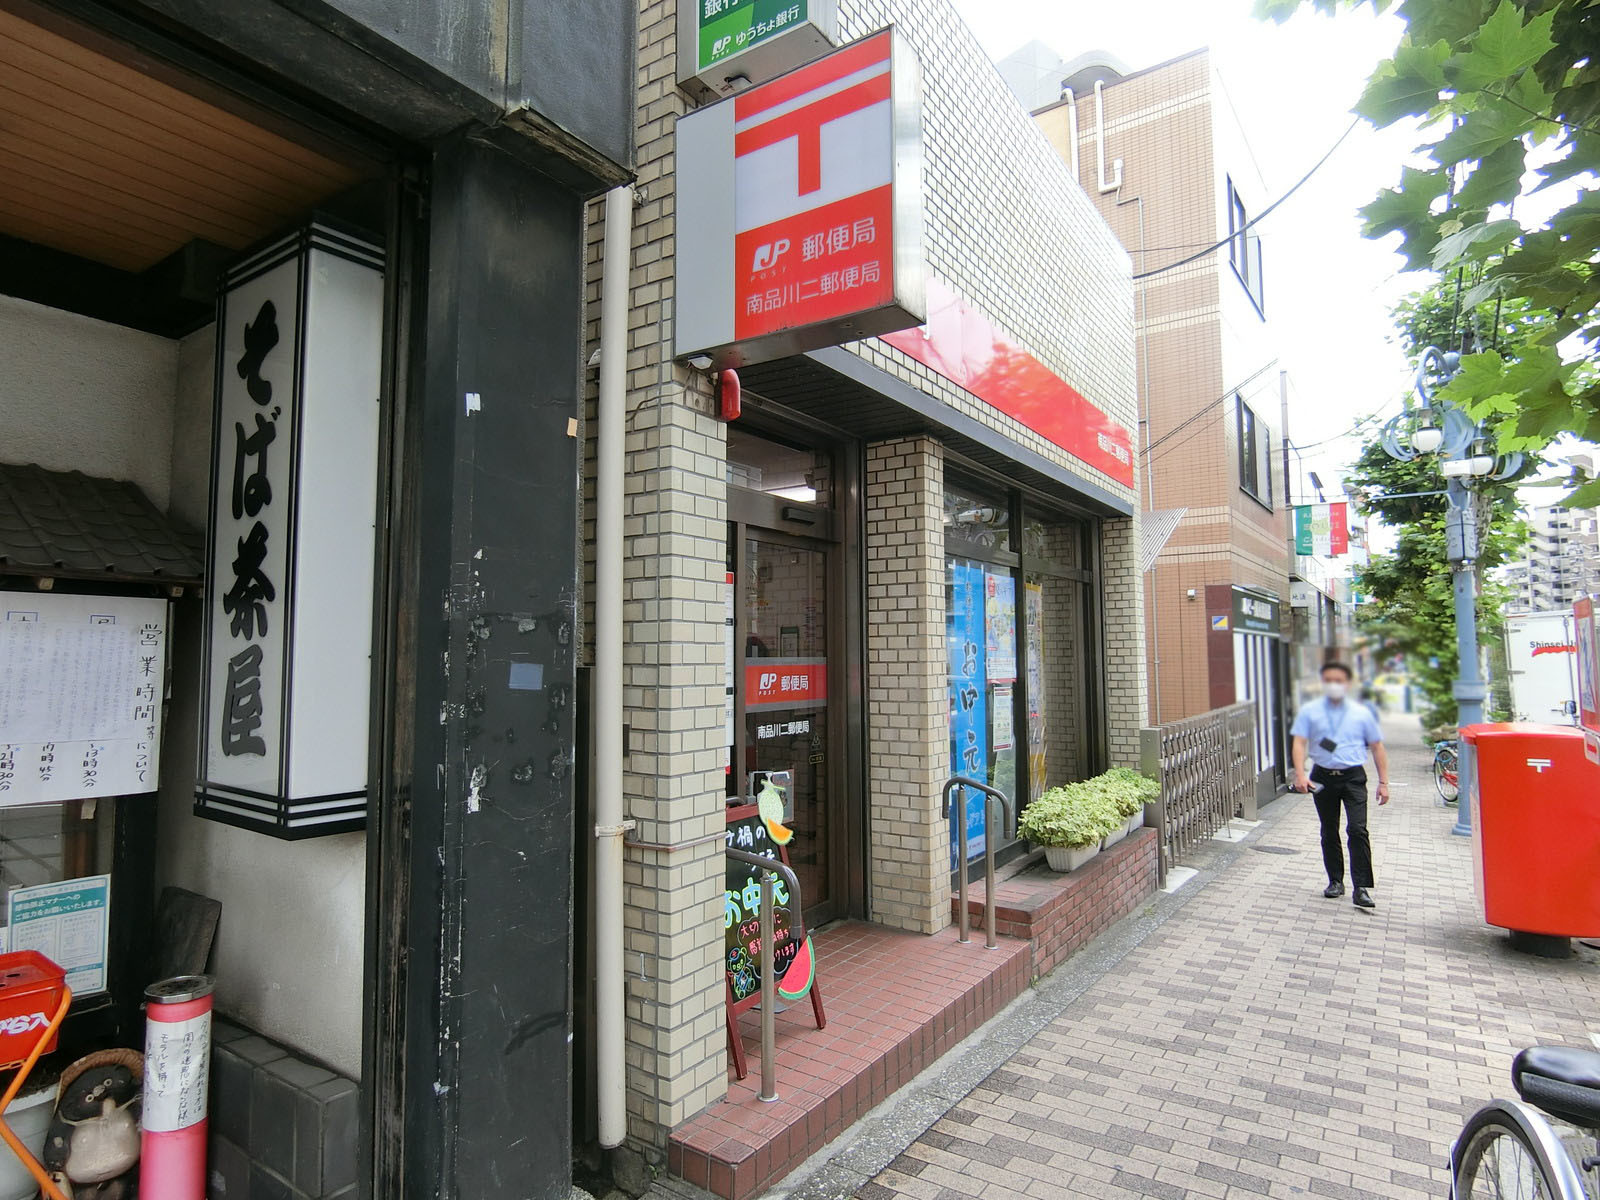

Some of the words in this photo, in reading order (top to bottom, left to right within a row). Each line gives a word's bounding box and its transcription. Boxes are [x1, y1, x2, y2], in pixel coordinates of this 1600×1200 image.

[736, 4, 800, 46] ゆうちょ銀行
[801, 217, 876, 262] 郵便局
[746, 260, 881, 316] 南品川二郵便局
[749, 266, 787, 283] POST
[221, 300, 281, 758] そば茶屋
[781, 675, 809, 691] 郵便局
[758, 721, 810, 739] 南品川二郵便局
